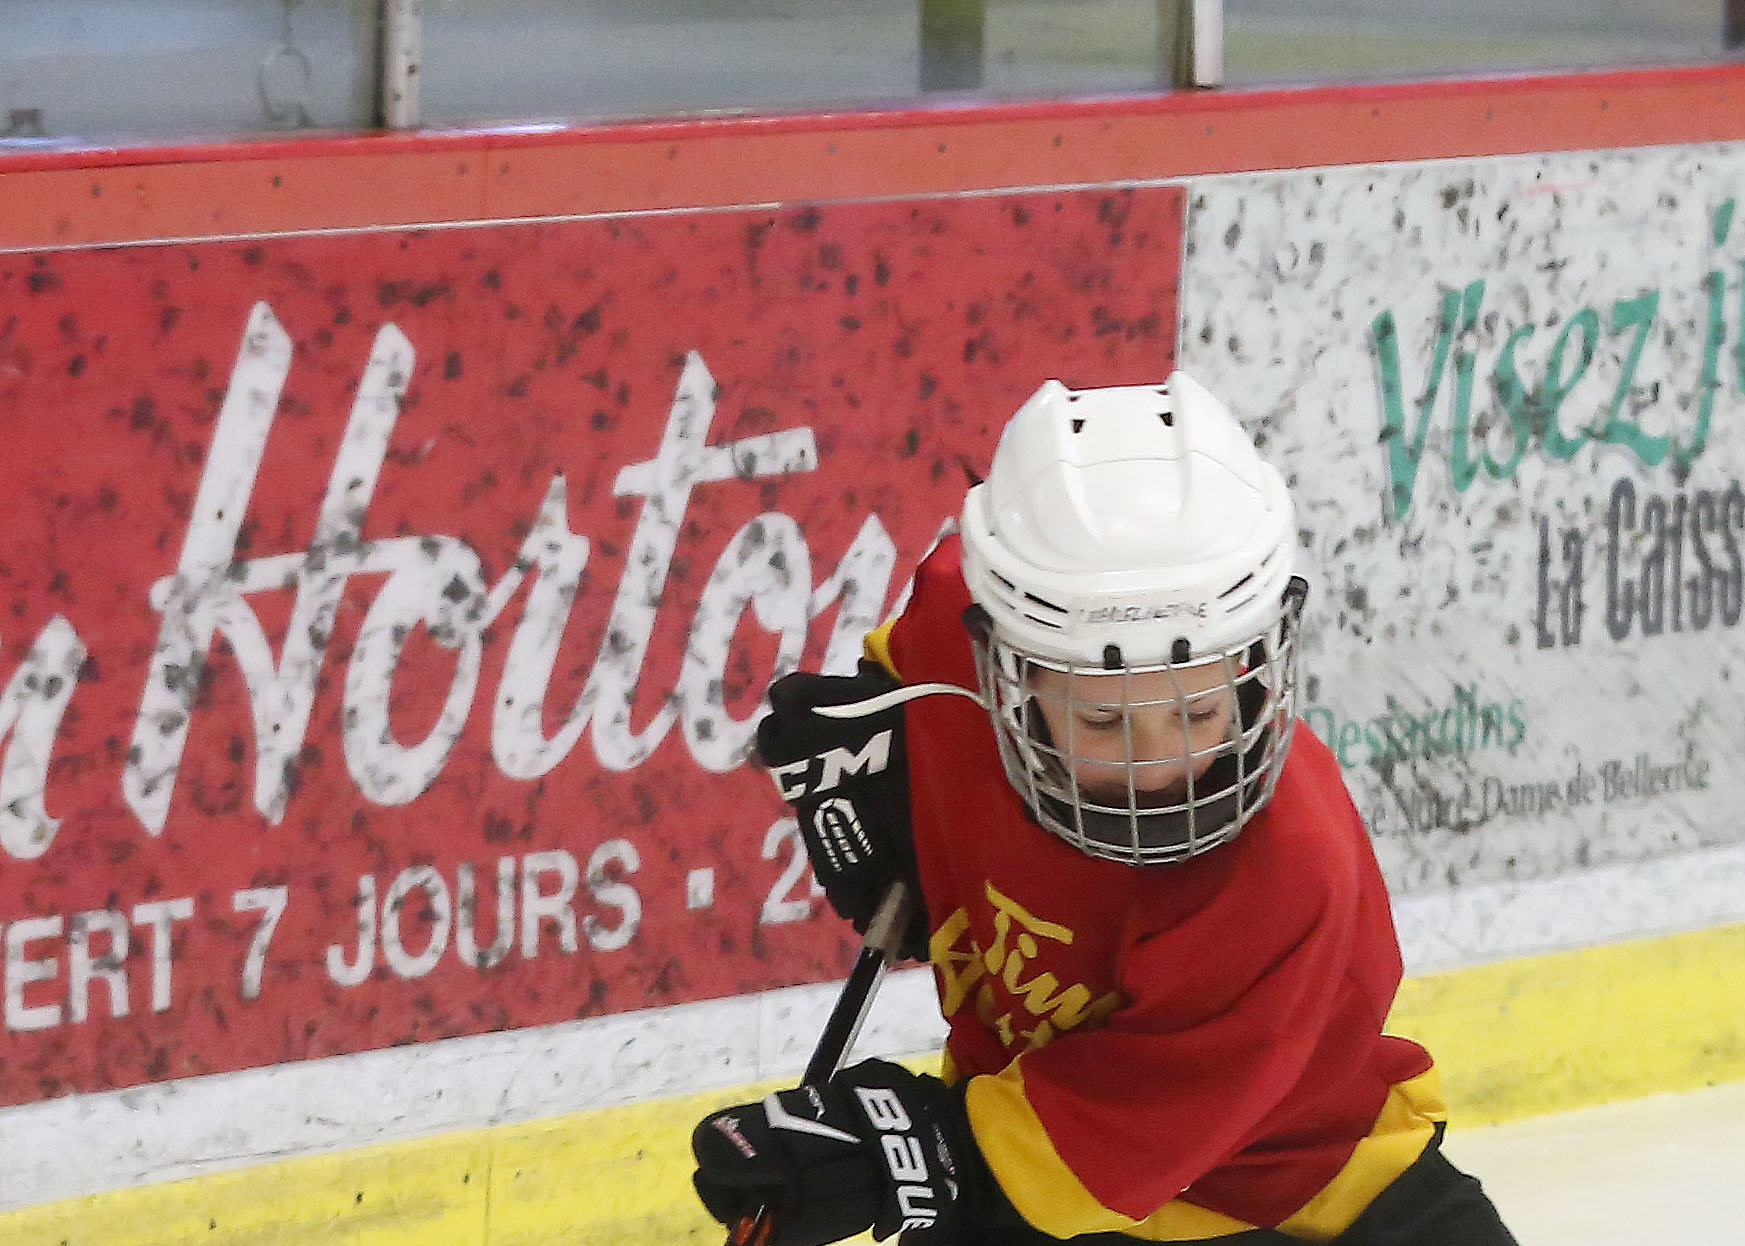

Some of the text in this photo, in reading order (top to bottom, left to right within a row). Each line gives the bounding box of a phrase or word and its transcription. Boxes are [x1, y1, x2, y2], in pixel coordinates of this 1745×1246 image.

[1372, 278, 1668, 520] Visez
[0, 815, 828, 1032] ERT 7 JOURS 2
